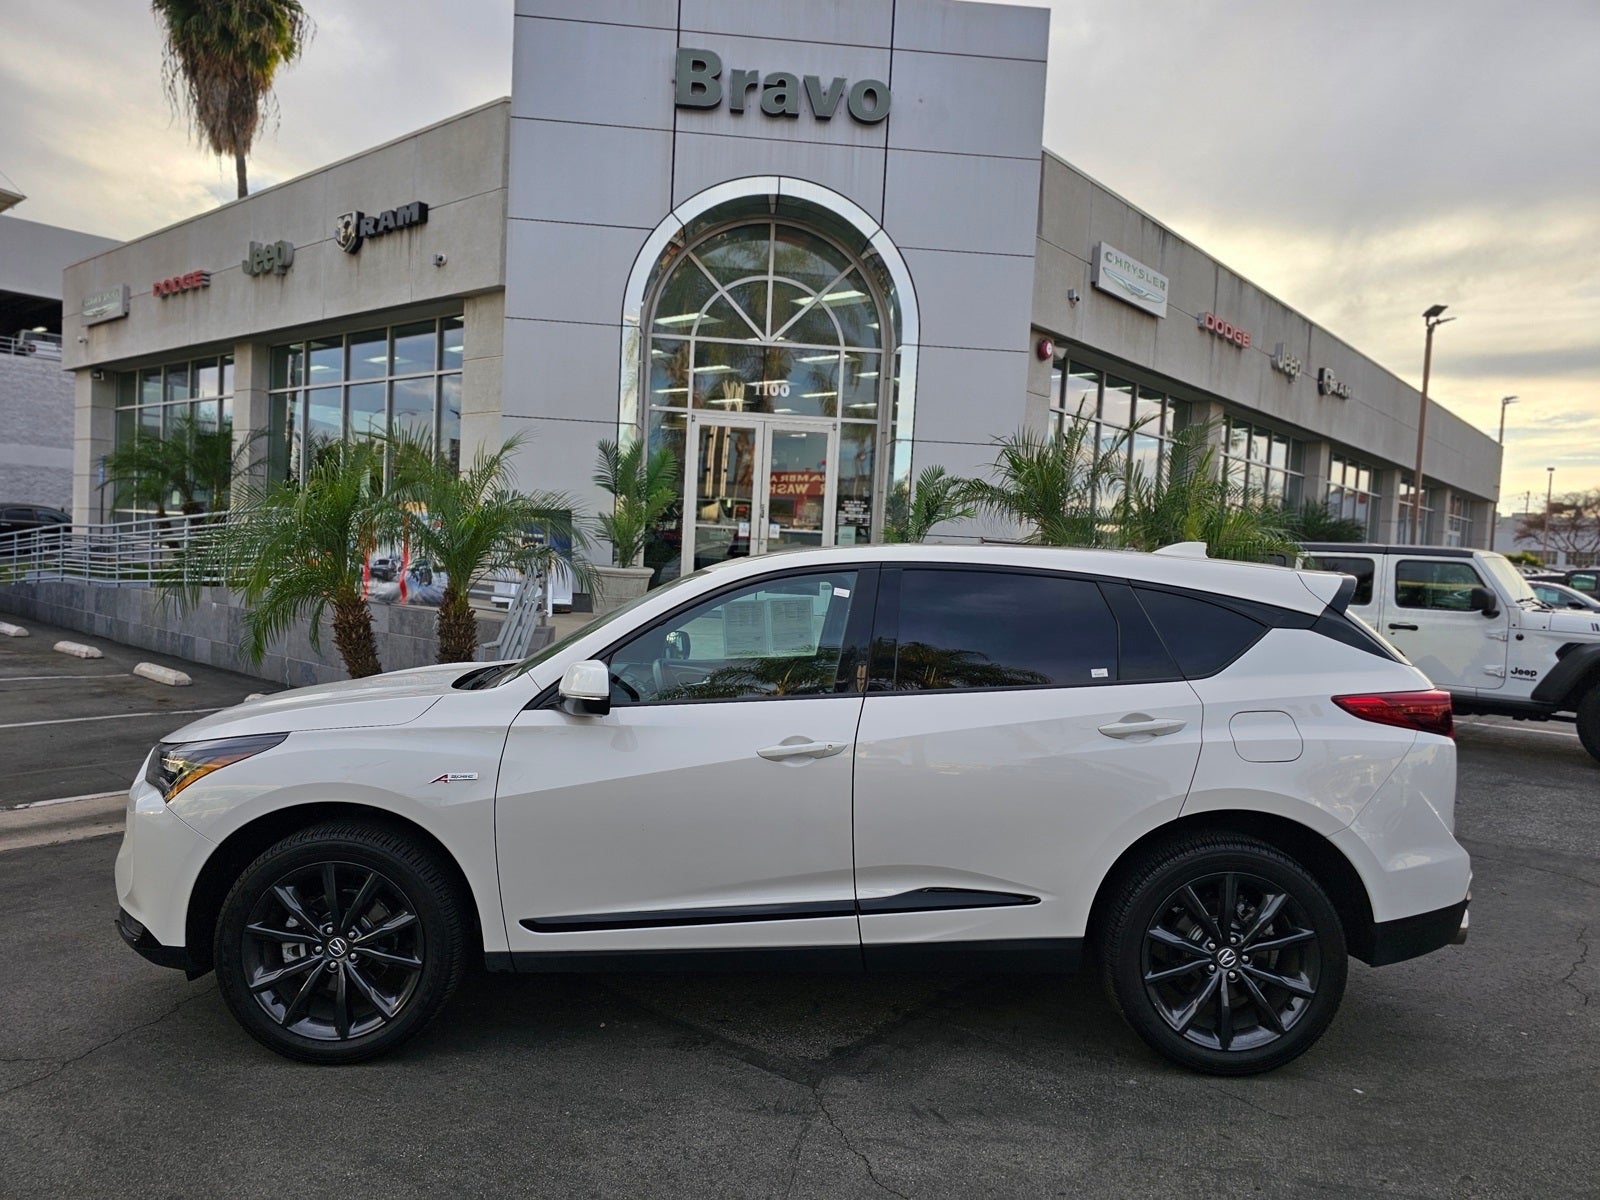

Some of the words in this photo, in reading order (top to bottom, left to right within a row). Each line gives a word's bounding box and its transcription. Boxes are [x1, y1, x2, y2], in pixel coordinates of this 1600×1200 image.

[675, 47, 891, 125] Bravo
[359, 201, 424, 238] RAM
[241, 240, 291, 276] Jeep
[1104, 251, 1166, 292] CHRYSLER
[152, 270, 205, 298] DODGE
[1204, 311, 1251, 348] DODGE
[1276, 342, 1302, 382] Jeep
[754, 382, 790, 398] 1100
[1510, 667, 1538, 677] Jeep
